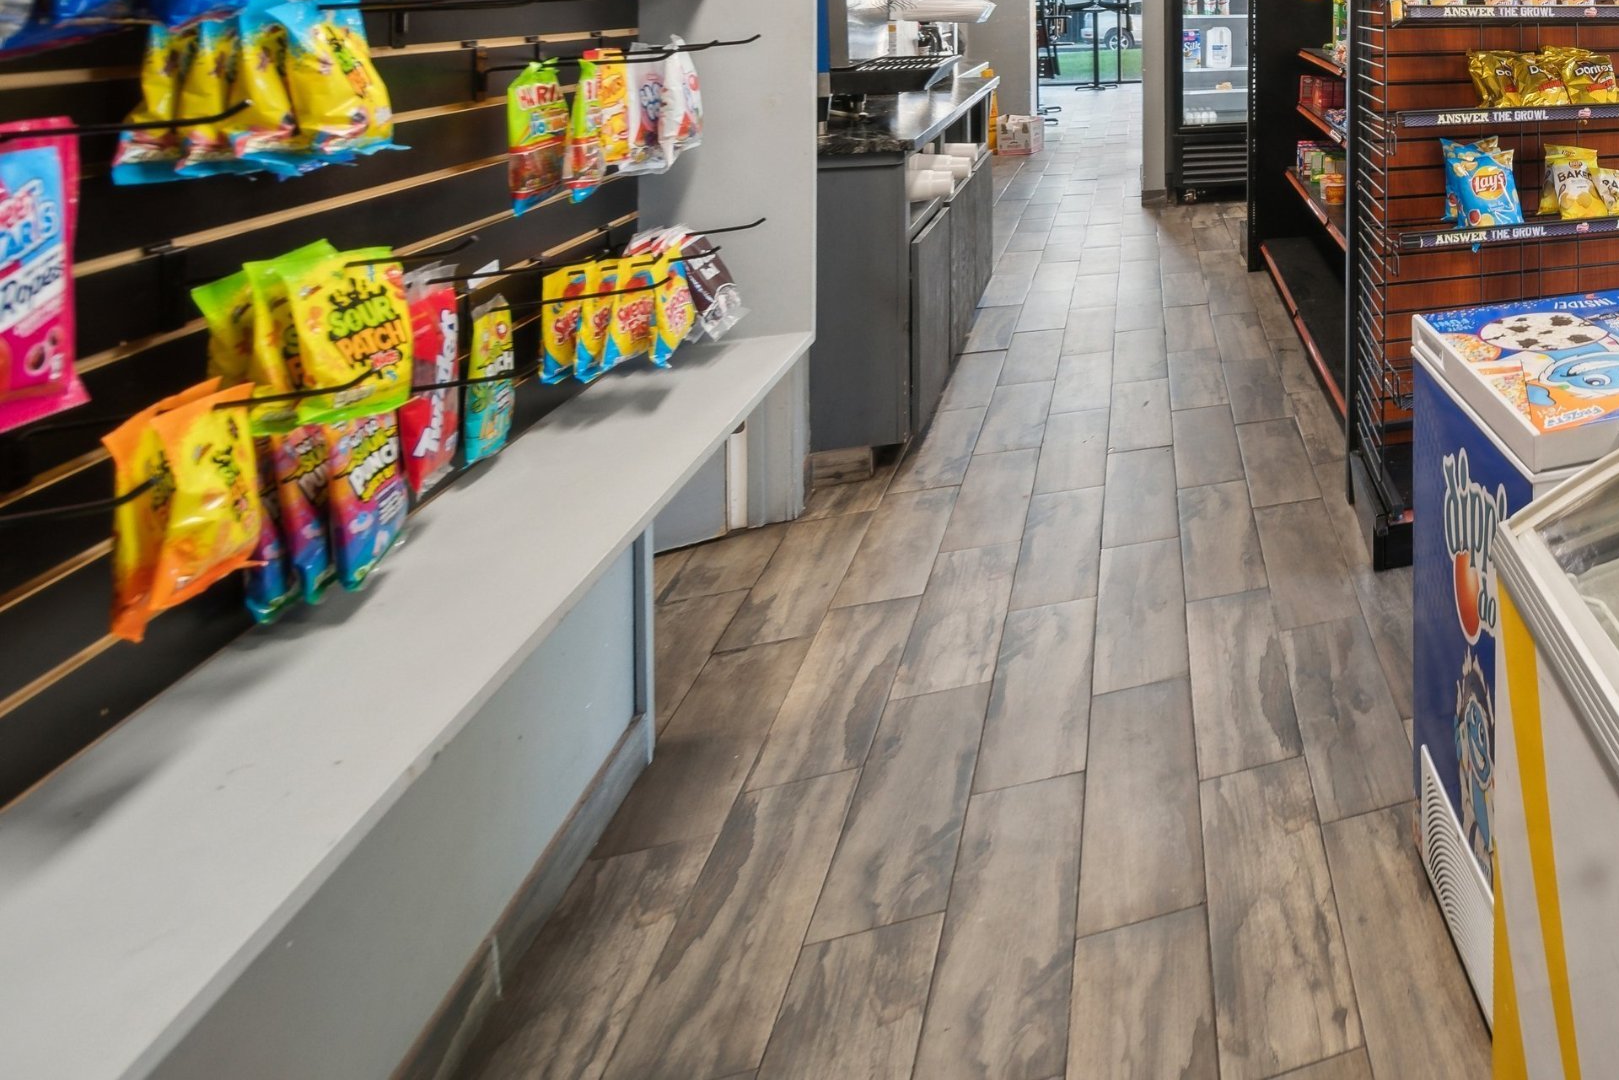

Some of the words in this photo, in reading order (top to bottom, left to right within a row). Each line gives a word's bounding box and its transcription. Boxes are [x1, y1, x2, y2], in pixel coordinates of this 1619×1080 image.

[1443, 7, 1494, 17] ANSWER
[1499, 7, 1517, 17] THE
[1520, 6, 1556, 17] GROWL
[1575, 63, 1613, 77] Doritos
[1437, 112, 1489, 124] ANSWER
[1492, 111, 1511, 122] THE
[1514, 109, 1549, 121] GROWL
[1436, 231, 1488, 245] ANSWER
[1491, 228, 1509, 239] THE
[1512, 226, 1548, 238] GROWL
[1553, 297, 1616, 309] INSIDE!
[328, 297, 395, 335] SOUR
[334, 320, 406, 366] PATCH
